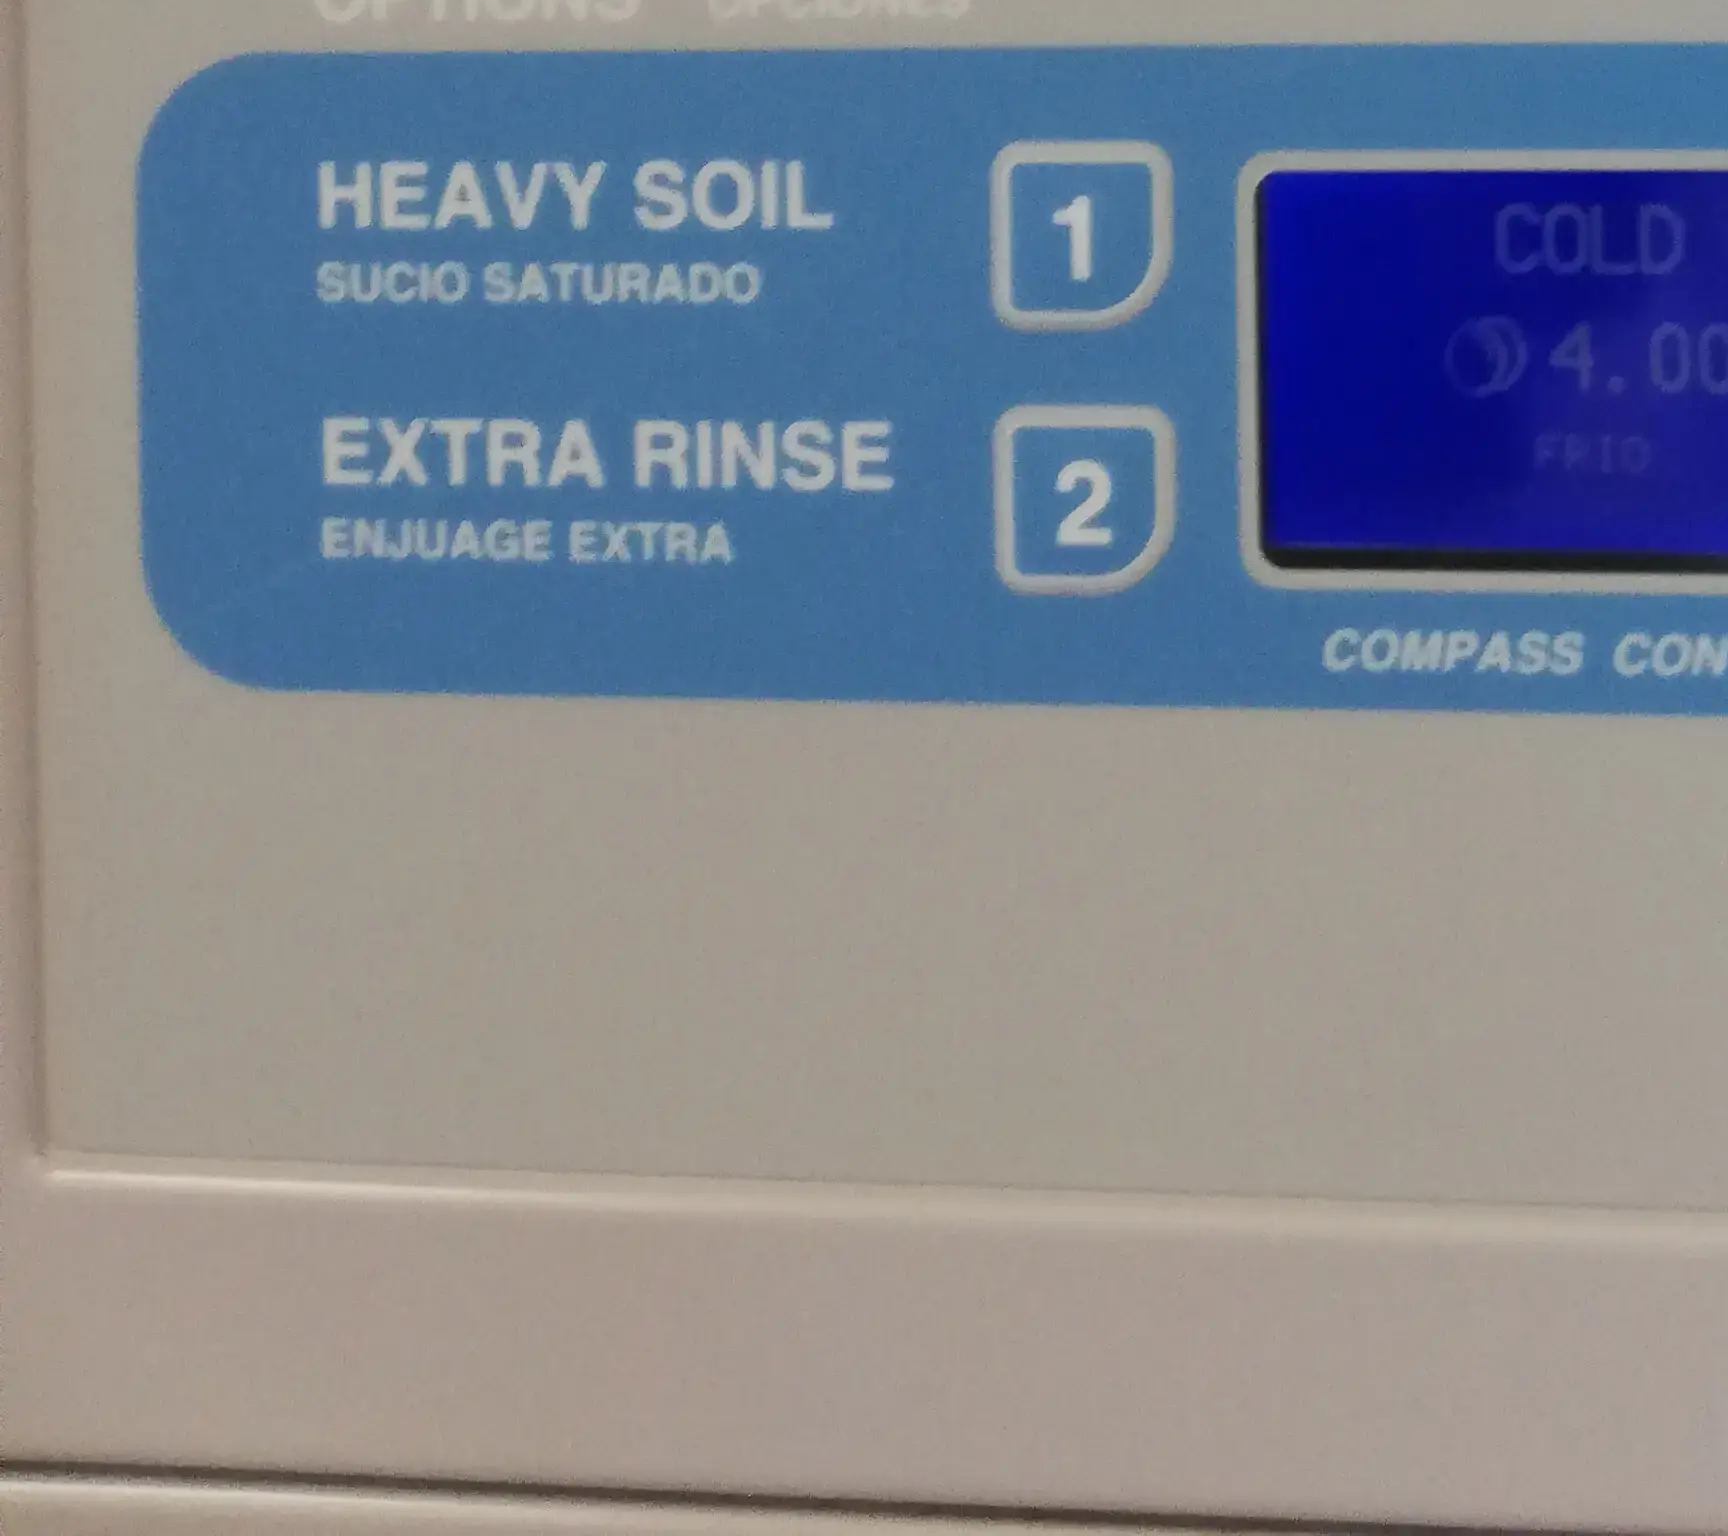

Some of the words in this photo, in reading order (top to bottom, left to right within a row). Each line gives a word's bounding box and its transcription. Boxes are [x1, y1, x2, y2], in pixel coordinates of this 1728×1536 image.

[317, 160, 608, 230] HEAVY
[634, 159, 834, 231] SOIL
[1053, 195, 1092, 281] 1
[1495, 202, 1685, 275] COLD
[317, 261, 467, 304] SUCIO
[484, 261, 761, 305] SATURADO
[322, 417, 606, 489] EXTRA
[634, 419, 894, 492] RINSE
[1535, 434, 1651, 474] FRIO
[1055, 459, 1113, 547] 2
[320, 517, 552, 563] ENJUAGE
[569, 522, 734, 565] EXTRA
[1322, 628, 1583, 676] COMPASS
